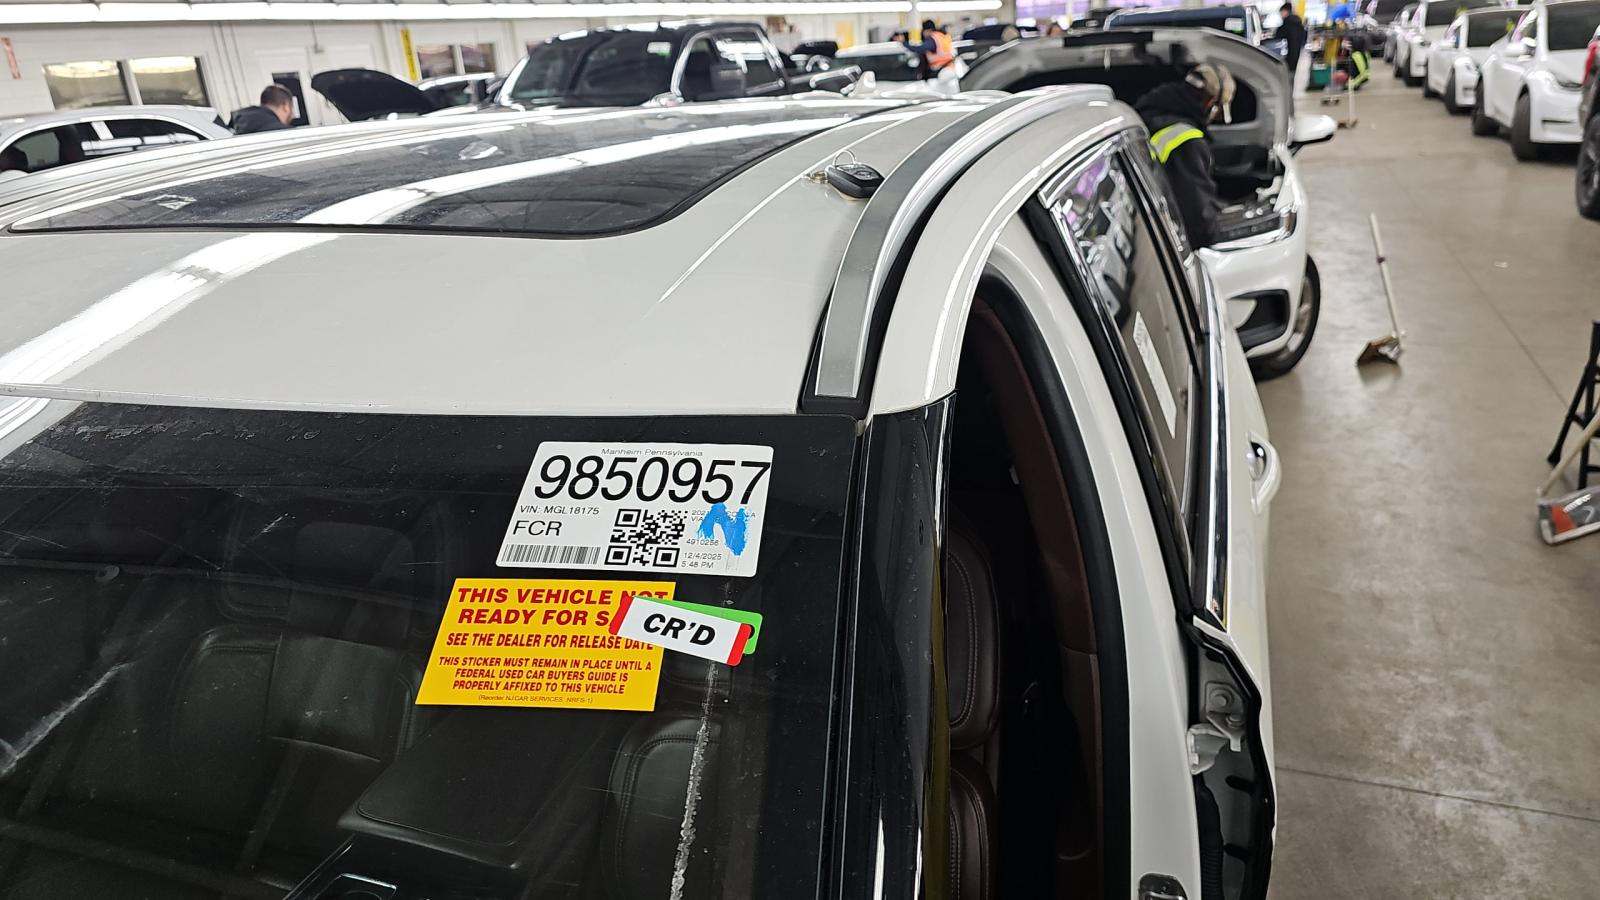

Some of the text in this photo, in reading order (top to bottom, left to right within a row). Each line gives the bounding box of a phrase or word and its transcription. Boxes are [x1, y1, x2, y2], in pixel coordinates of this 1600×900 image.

[601, 448, 703, 457] Manheim Pennsylvania
[534, 454, 771, 505] 9850957
[520, 505, 600, 515] VIN: MGL18175
[512, 520, 562, 536] FCR
[683, 552, 722, 560] 12/4/2025
[700, 561, 714, 569] PM
[458, 588, 509, 603] THIS
[517, 588, 613, 605] VEHICLE
[457, 608, 537, 625] READY
[542, 609, 588, 626] FOR
[446, 632, 469, 646] SEE
[472, 632, 495, 647] THE
[496, 633, 542, 647] DEALER
[543, 634, 567, 647] FOR
[569, 634, 622, 649] RELEASE
[439, 657, 652, 671] THIS STICKER MUST REMAIN IN PLACE UNTIL A
[455, 668, 629, 682] FEDERAL USED CAR BUYERS GUIDE IS
[452, 680, 626, 694] PROPERLY AFFIXED TO THIS VEHICLE
